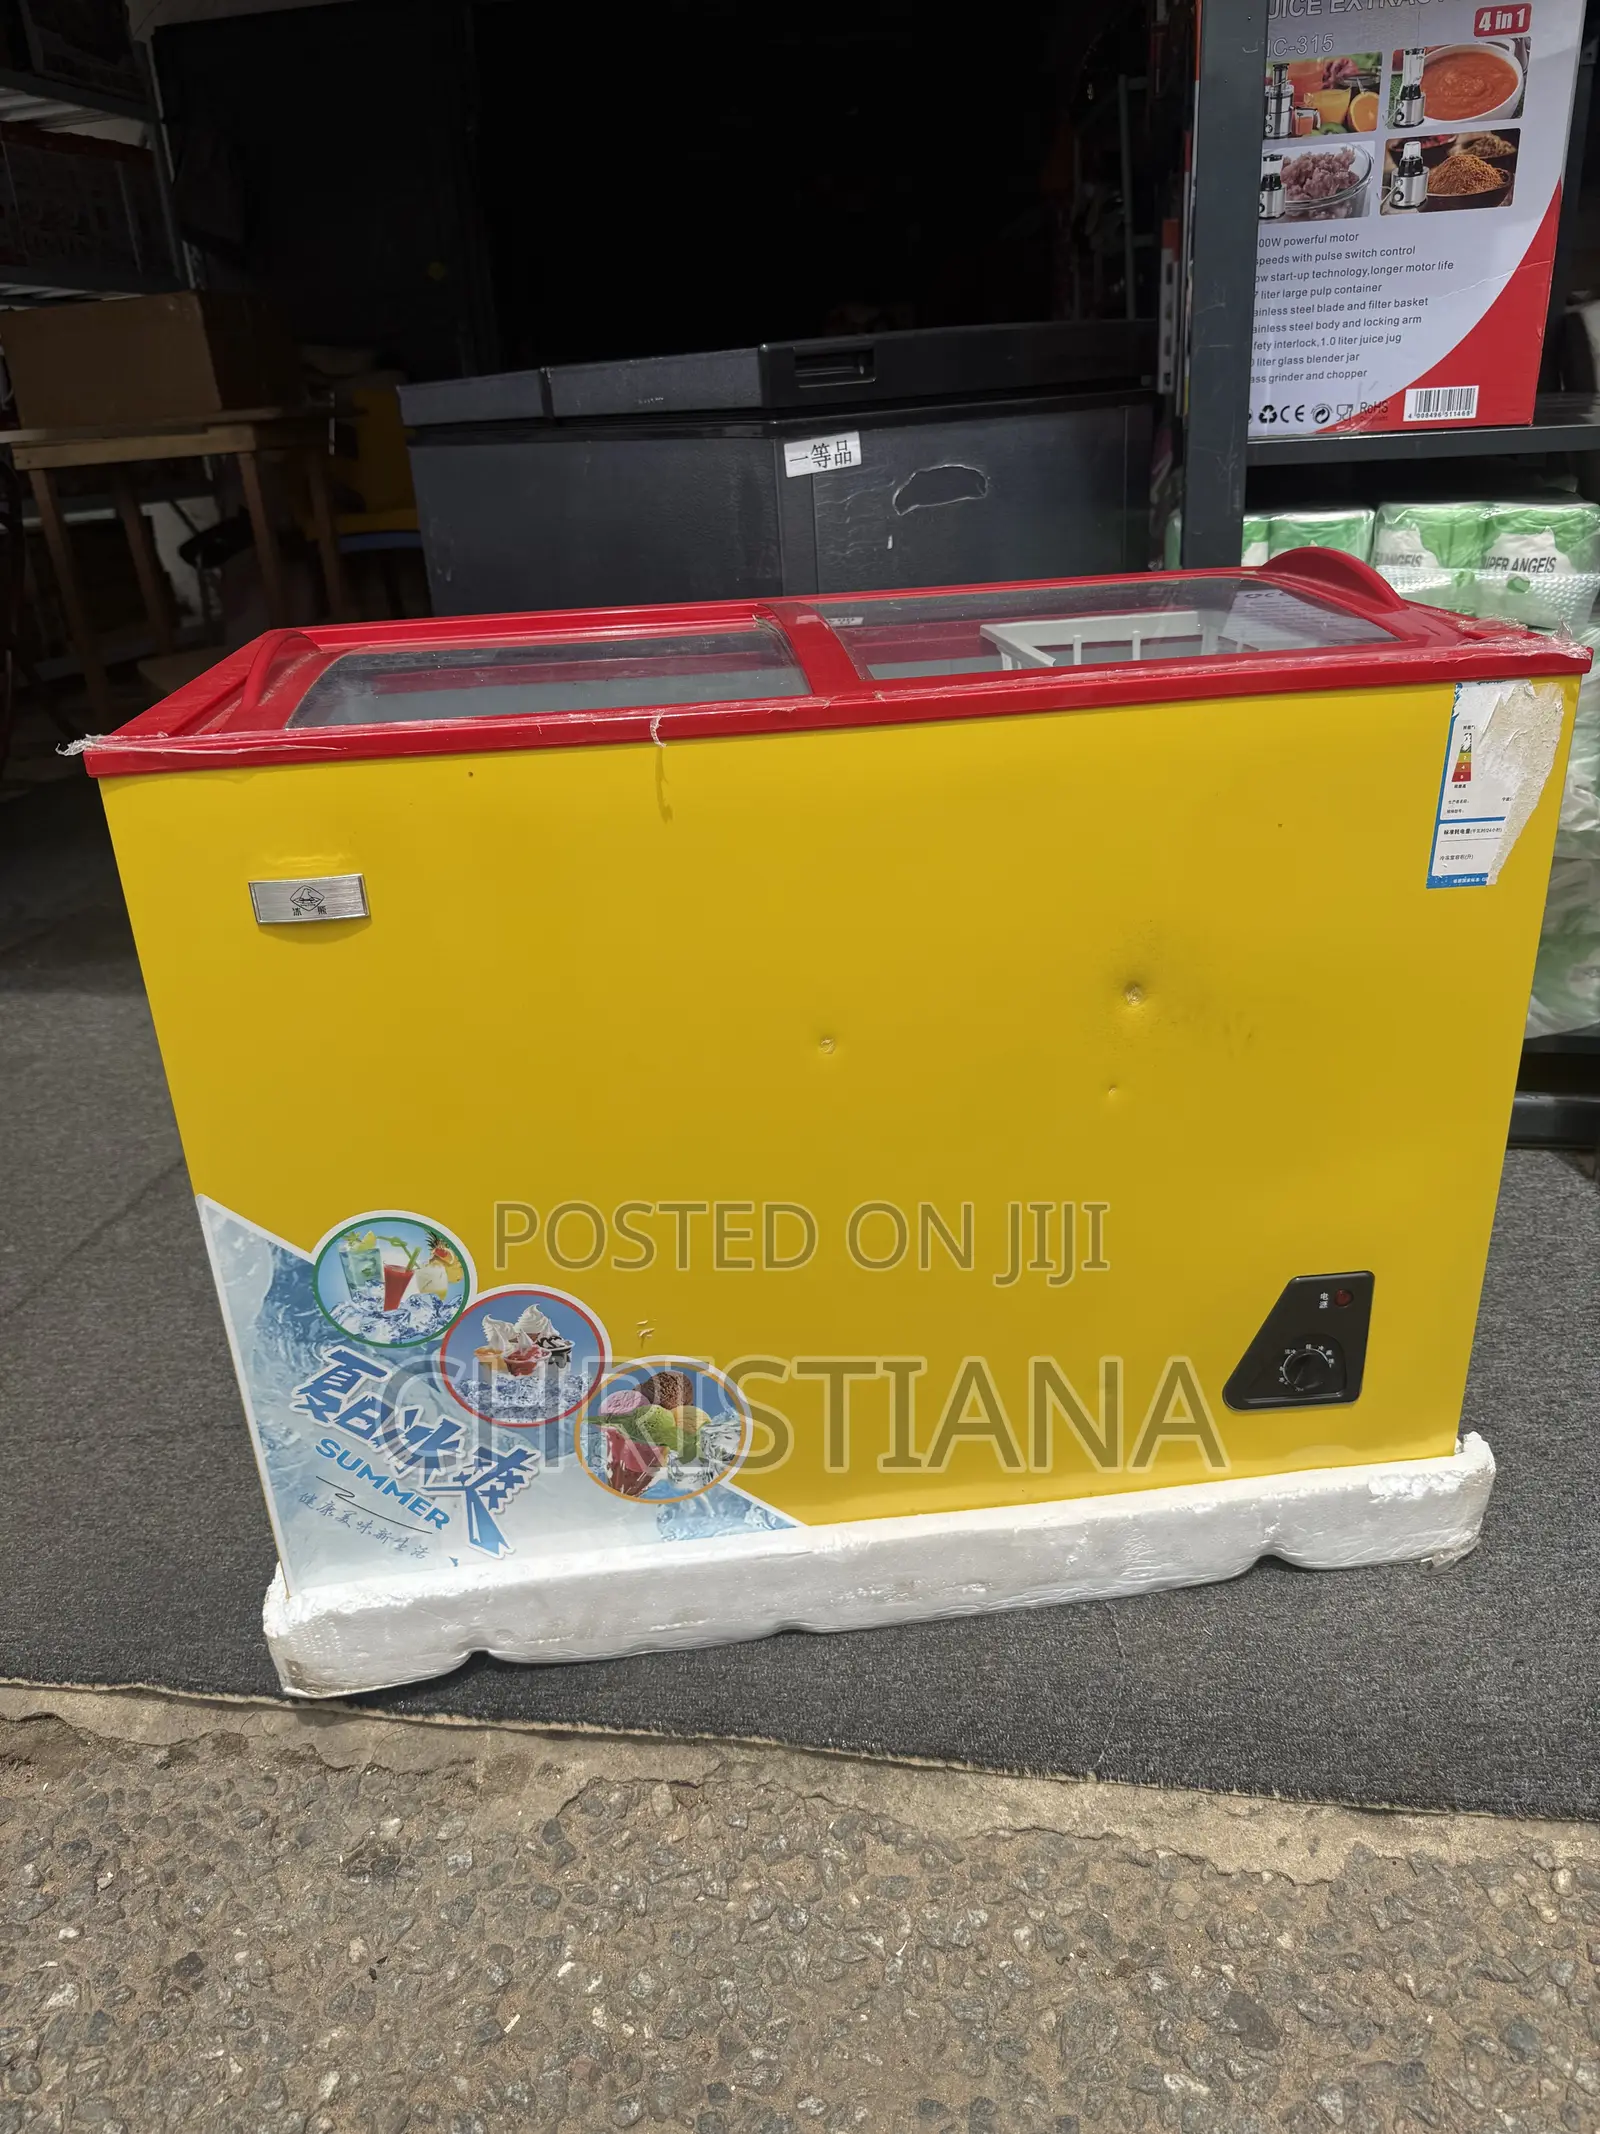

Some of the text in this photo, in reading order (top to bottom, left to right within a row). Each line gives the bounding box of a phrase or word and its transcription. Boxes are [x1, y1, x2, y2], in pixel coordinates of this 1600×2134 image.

[1478, 8, 1526, 31] 4 in 1
[1284, 234, 1327, 247] powerful
[1329, 233, 1359, 243] motor
[1292, 252, 1313, 263] with
[1315, 250, 1342, 263] pulse
[1345, 249, 1377, 259] switch
[1380, 246, 1415, 257] control
[1270, 270, 1309, 282] start-up
[1406, 262, 1435, 272] motor
[1438, 261, 1454, 270] life
[1261, 290, 1280, 300] liter
[1282, 287, 1307, 299] large
[1310, 286, 1331, 299] pulp
[1334, 284, 1382, 295] container
[1290, 304, 1314, 315] steel
[1317, 302, 1345, 313] blade
[1347, 301, 1365, 311] and
[1368, 299, 1391, 309] filter
[1393, 297, 1428, 308] basket
[1289, 322, 1313, 332] steel
[1316, 320, 1340, 332] body
[1342, 319, 1360, 328] and
[1364, 316, 1399, 329] locking
[1402, 315, 1421, 324] arm
[1338, 336, 1357, 345] liter
[1358, 334, 1383, 345] juice
[1385, 333, 1401, 344] jug
[1257, 357, 1276, 367] liter
[1278, 355, 1304, 368] glass
[1306, 353, 1344, 364] blender
[1345, 352, 1359, 364] jar
[1269, 372, 1303, 384] grinder
[1306, 370, 1324, 381] and
[1326, 368, 1367, 381] chopper
[789, 438, 853, 469] 一等品
[315, 1437, 451, 1530] SUMMER
